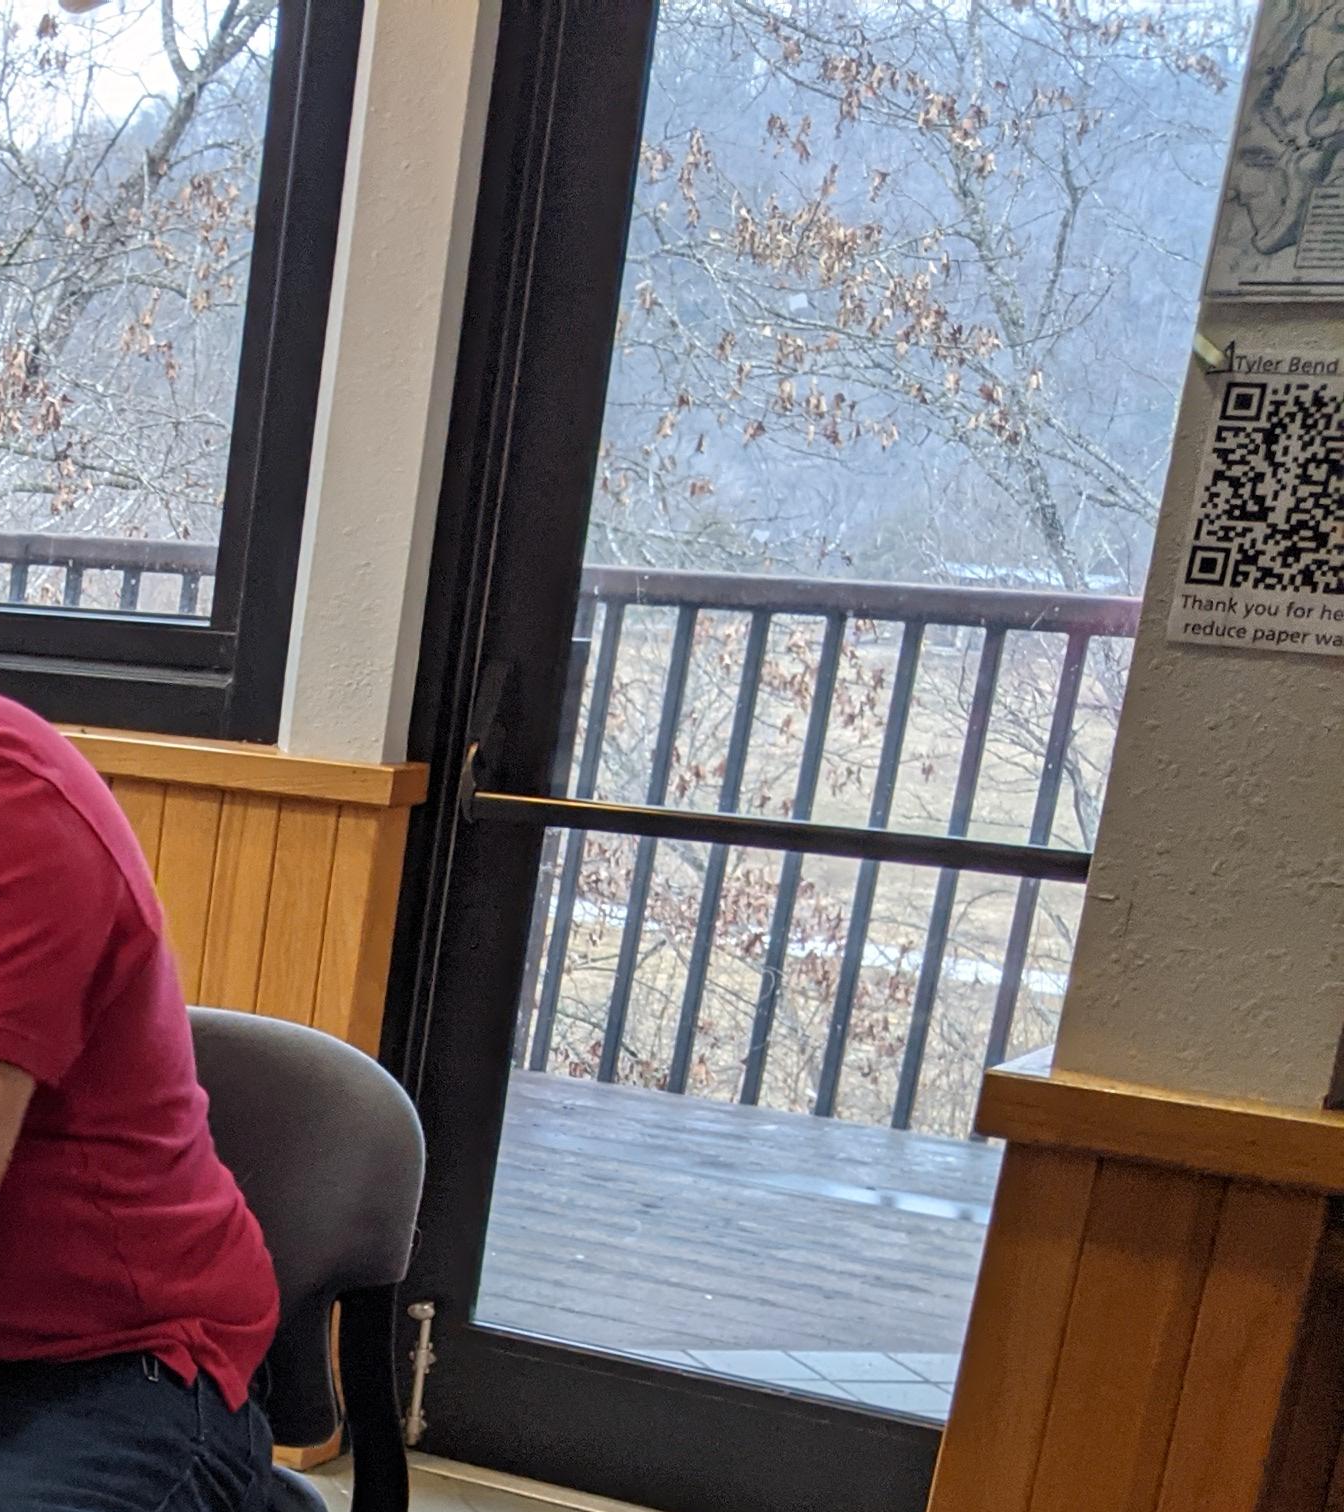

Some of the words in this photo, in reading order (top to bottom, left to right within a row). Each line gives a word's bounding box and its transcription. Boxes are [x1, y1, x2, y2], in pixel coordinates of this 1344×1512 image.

[1235, 355, 1283, 375] Tyler
[1287, 356, 1339, 375] Bend
[1181, 593, 1239, 614] Thank
[1242, 602, 1280, 618] you
[1285, 601, 1315, 619] for
[1320, 604, 1344, 622] he
[1183, 620, 1247, 639] reduce
[1252, 627, 1311, 646] paper
[1315, 632, 1344, 648] wa
